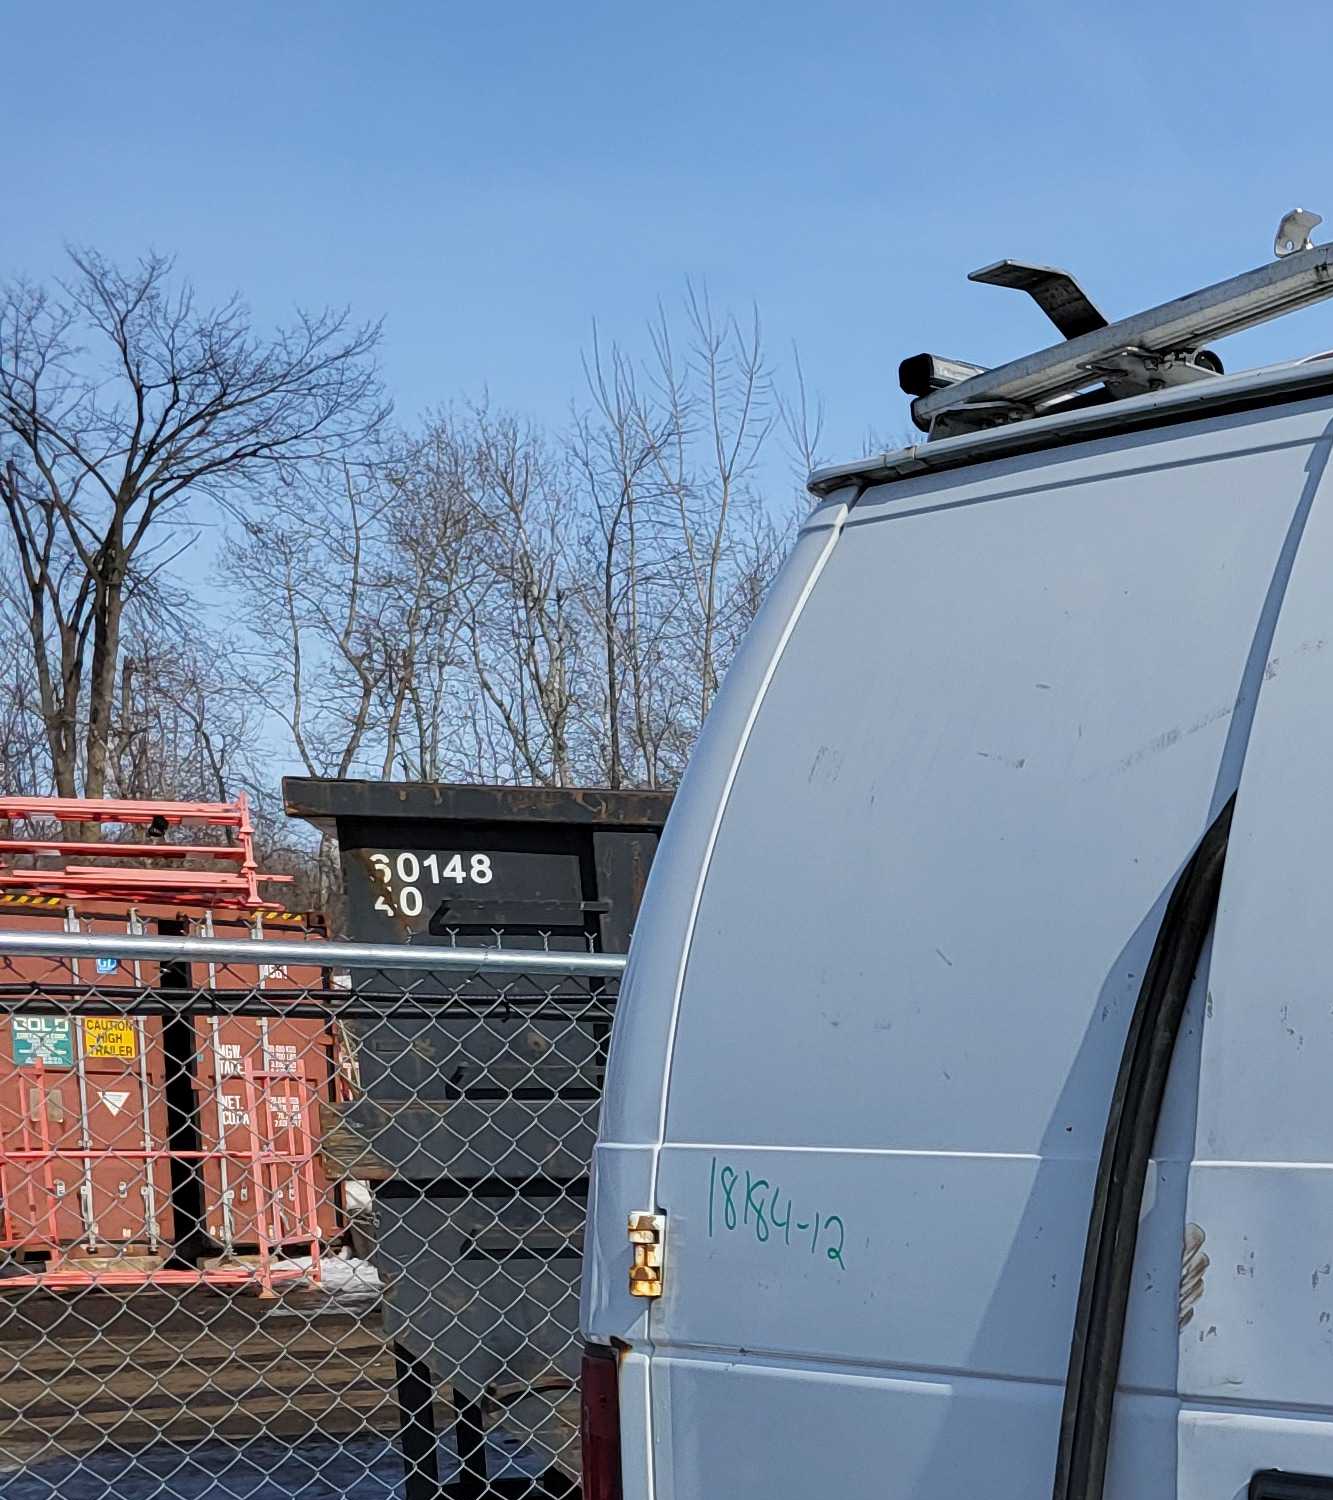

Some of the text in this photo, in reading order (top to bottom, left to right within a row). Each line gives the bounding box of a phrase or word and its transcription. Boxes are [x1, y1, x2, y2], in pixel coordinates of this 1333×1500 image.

[96, 1032, 122, 1043] HIGH
[89, 1045, 132, 1056] TRAILER
[708, 1157, 846, 1270] 18184-12
